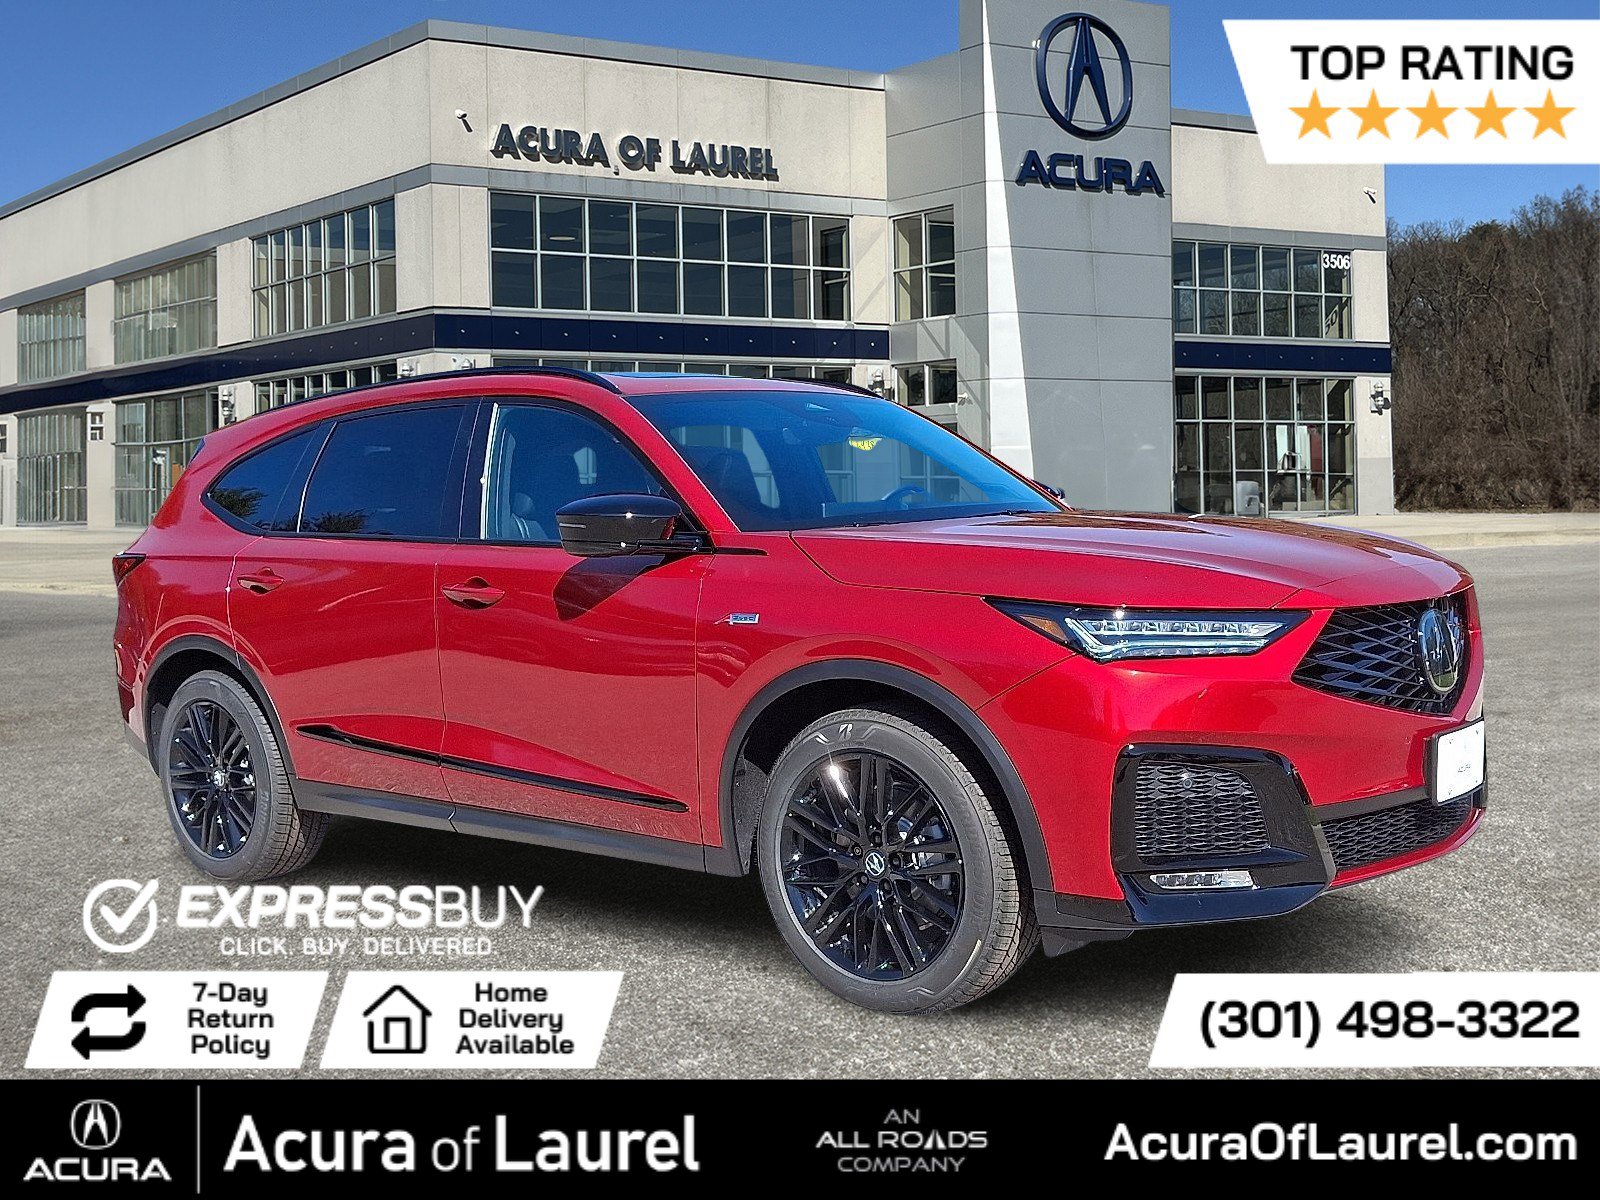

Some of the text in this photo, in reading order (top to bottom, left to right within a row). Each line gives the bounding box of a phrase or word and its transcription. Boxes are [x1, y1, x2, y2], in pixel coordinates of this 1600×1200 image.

[490, 123, 779, 182] ACURA OF LAUREL
[1015, 149, 1166, 198] ACURA
[1322, 253, 1351, 270] 3506
